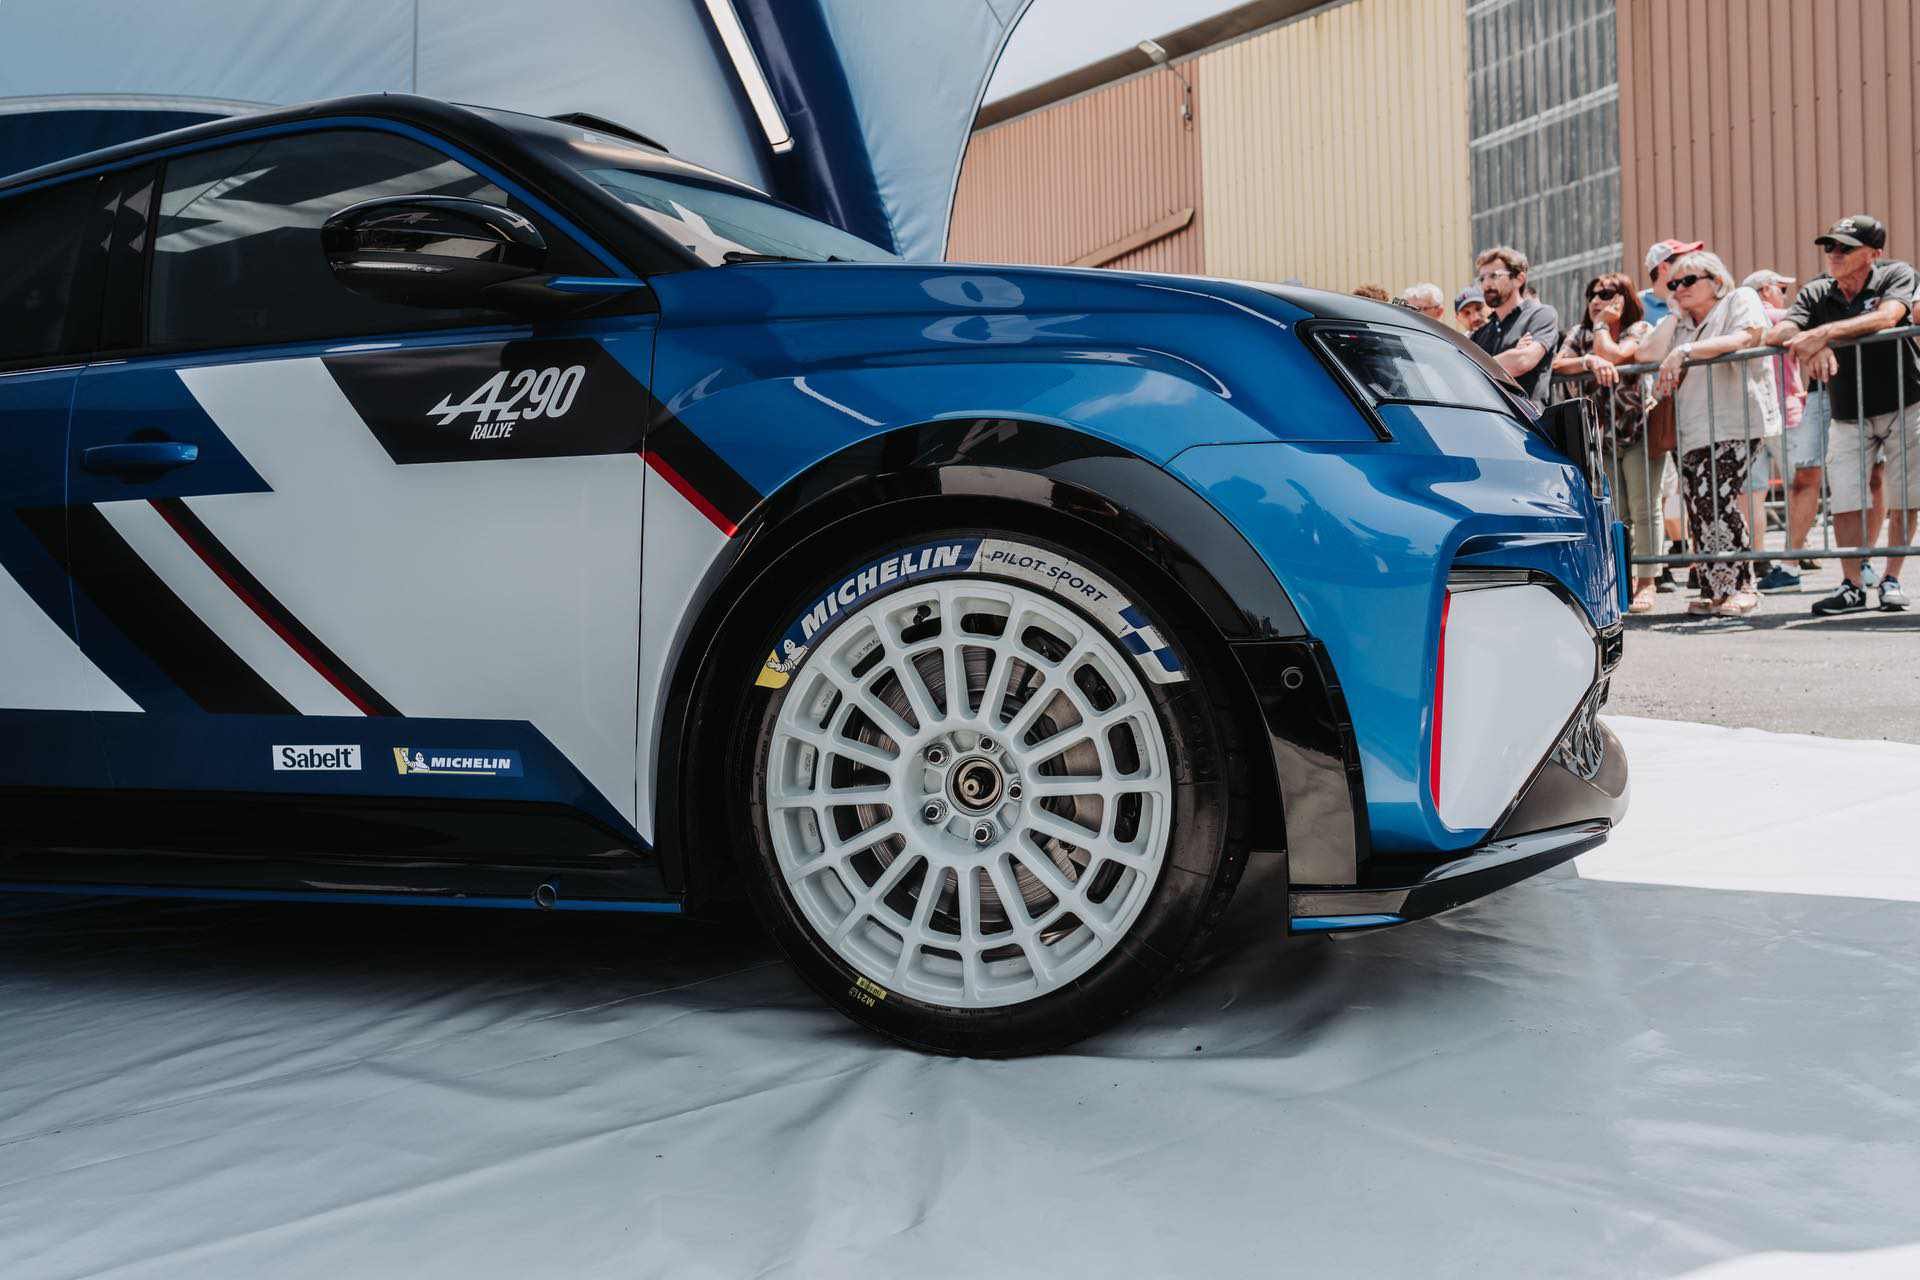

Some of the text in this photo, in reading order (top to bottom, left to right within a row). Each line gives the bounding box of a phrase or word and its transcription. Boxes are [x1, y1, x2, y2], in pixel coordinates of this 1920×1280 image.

[470, 422, 515, 440] RALLYE
[990, 551, 1108, 602] PILOT SPORT
[801, 545, 962, 640] MICHELIN
[281, 747, 351, 768] Sabelt
[431, 757, 511, 769] MICHELIN
